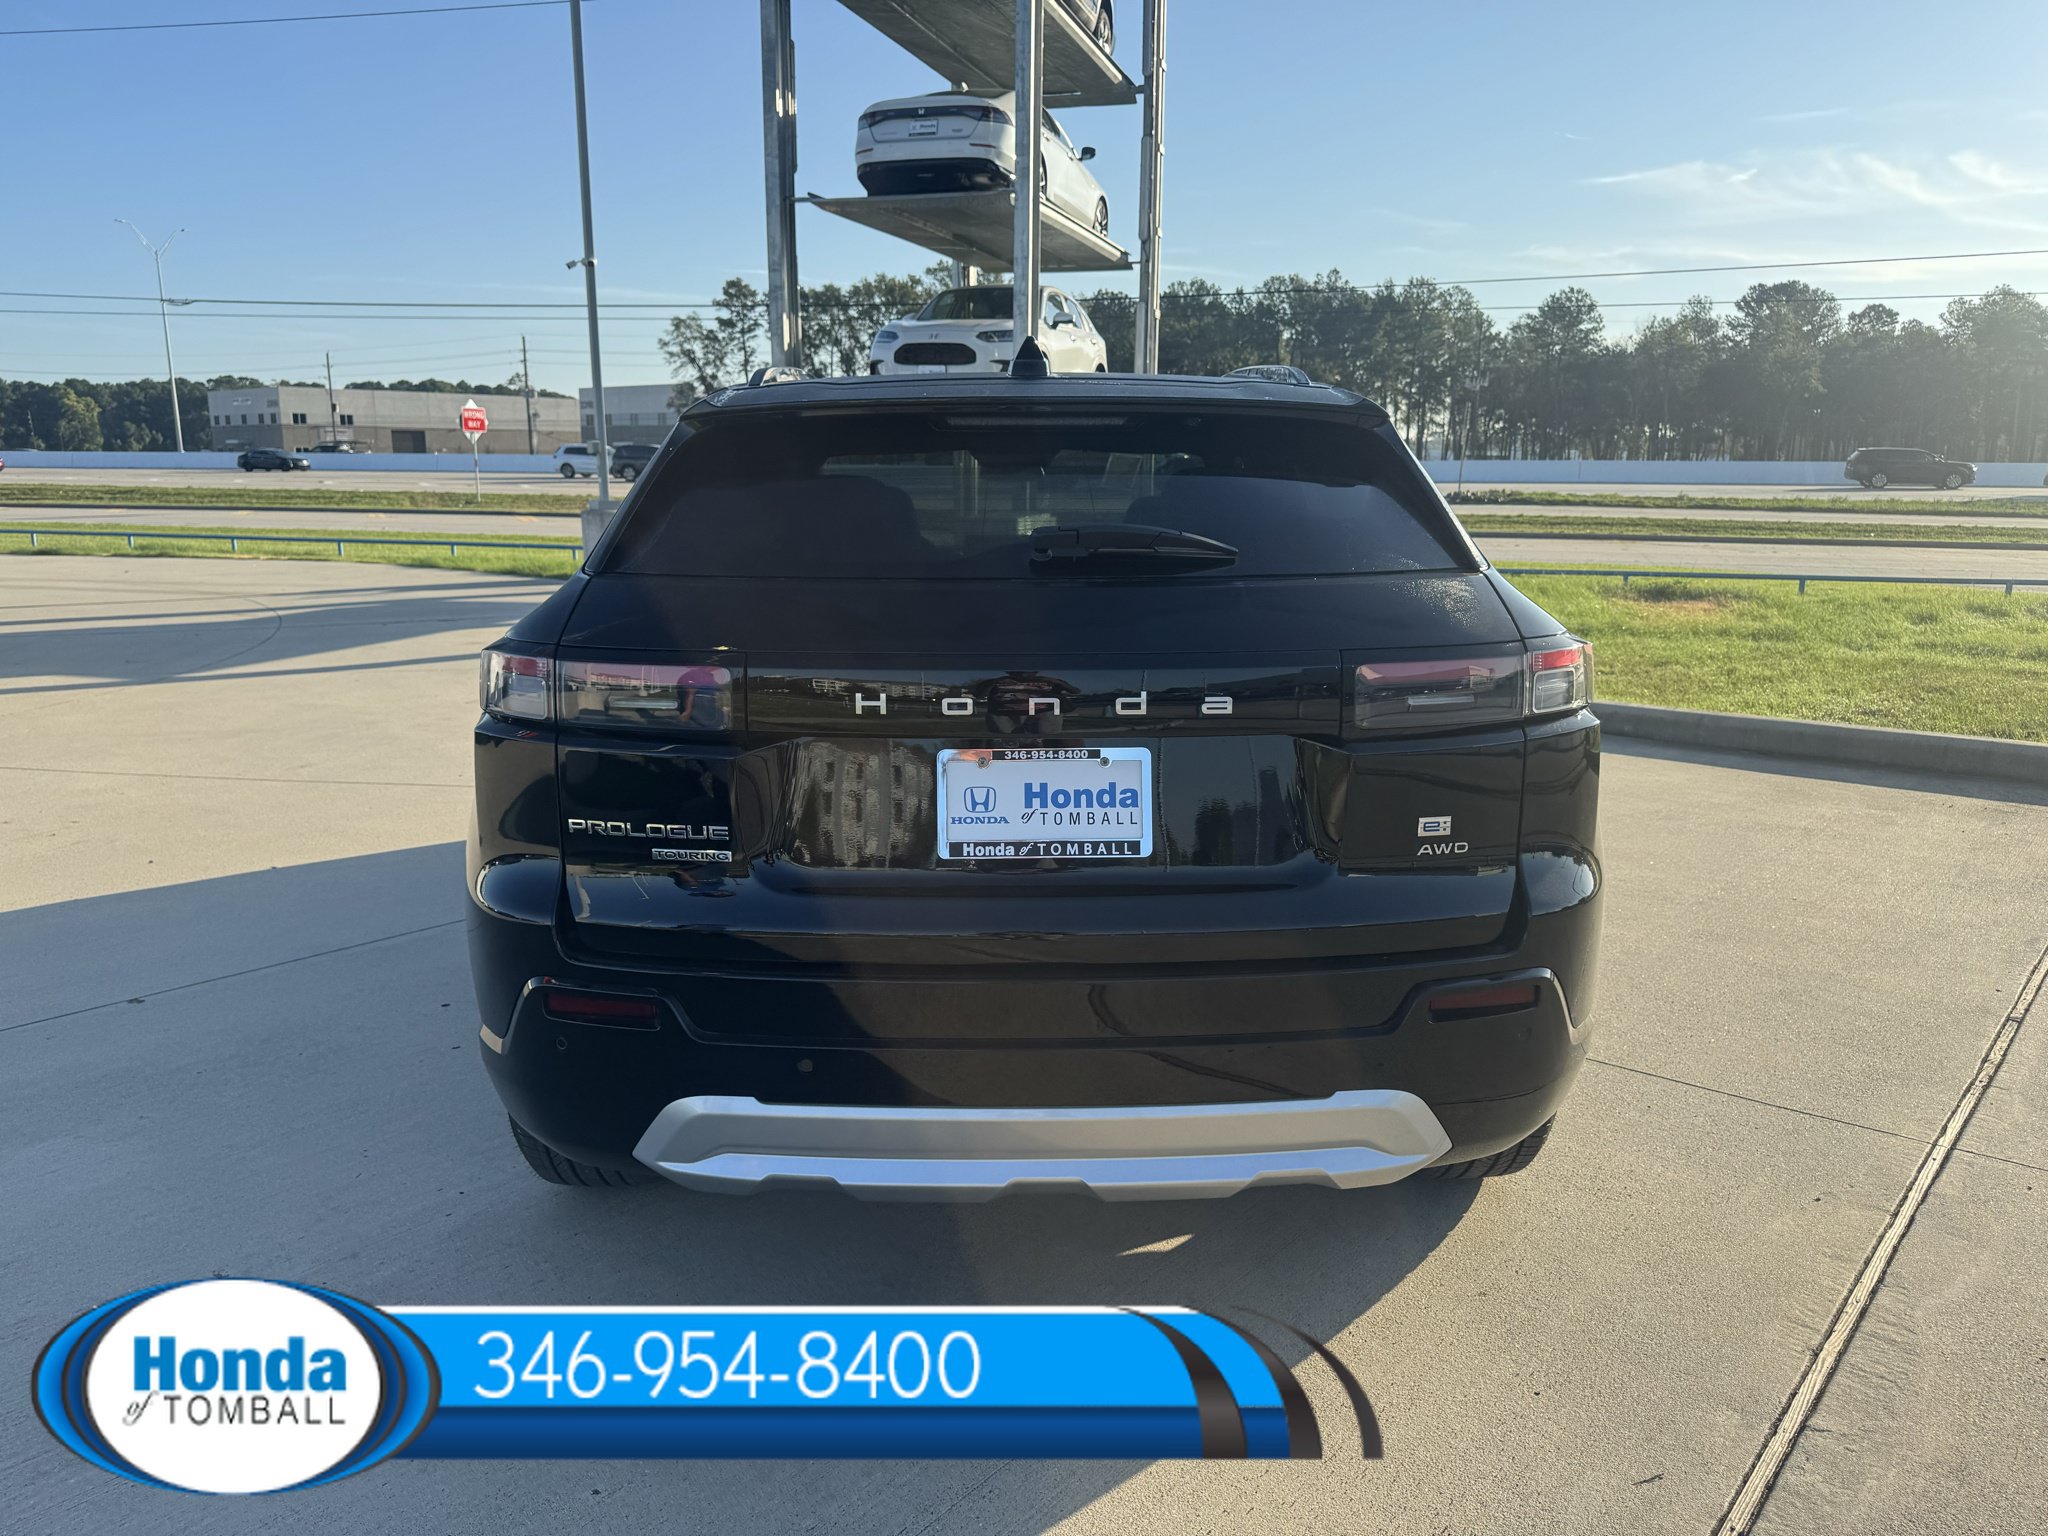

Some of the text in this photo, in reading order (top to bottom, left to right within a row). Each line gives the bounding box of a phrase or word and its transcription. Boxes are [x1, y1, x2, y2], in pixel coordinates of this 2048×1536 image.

[855, 691, 1233, 715] Honda
[1004, 751, 1089, 760] 346-954-8400
[1023, 782, 1139, 809] Honda
[951, 816, 1010, 824] HONDA
[1021, 809, 1138, 825] of TOMBALL
[568, 819, 729, 840] PROLOGUE
[654, 850, 729, 861] TOURING
[963, 842, 1132, 857] Honda of TOMBALL
[1417, 842, 1469, 856] AWD
